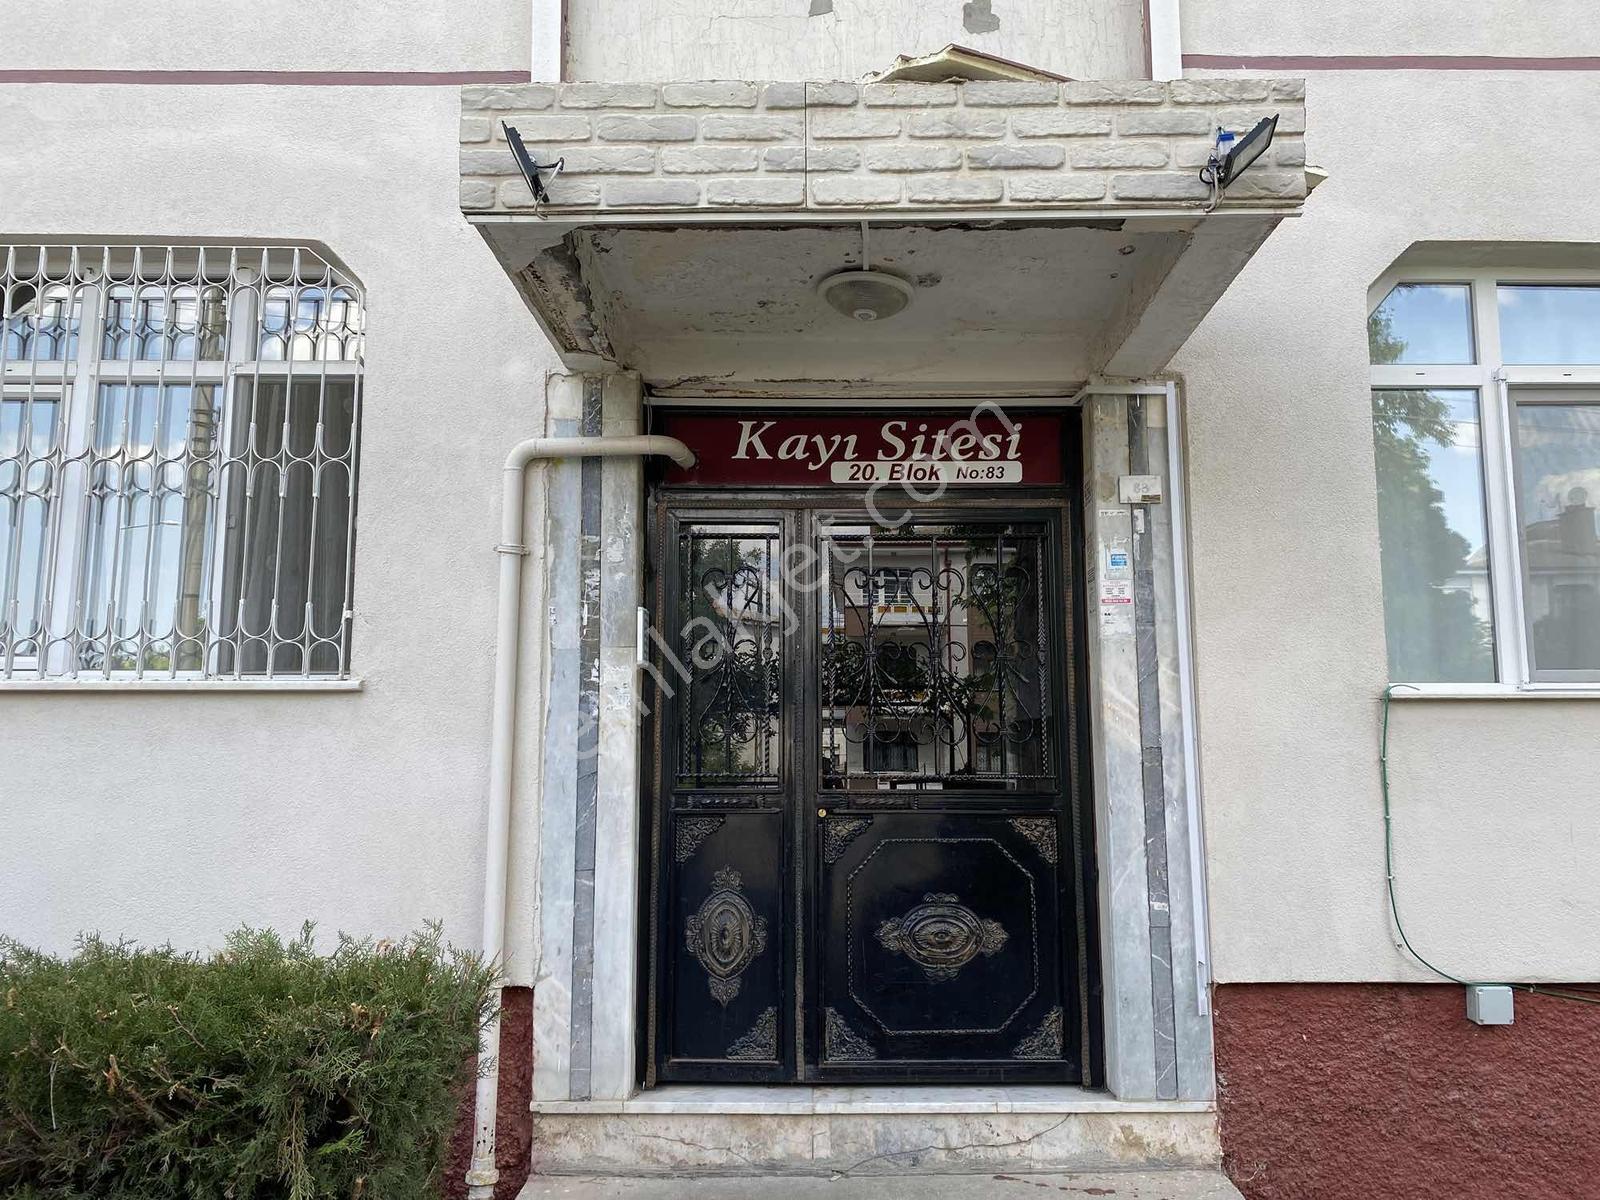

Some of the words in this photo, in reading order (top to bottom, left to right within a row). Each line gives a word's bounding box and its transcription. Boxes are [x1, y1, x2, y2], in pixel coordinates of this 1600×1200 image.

[731, 420, 859, 471] Kayı
[877, 420, 1023, 461] Sitesi
[848, 463, 880, 481] 20.
[889, 463, 942, 481] Blok
[956, 465, 1006, 480] No:83
